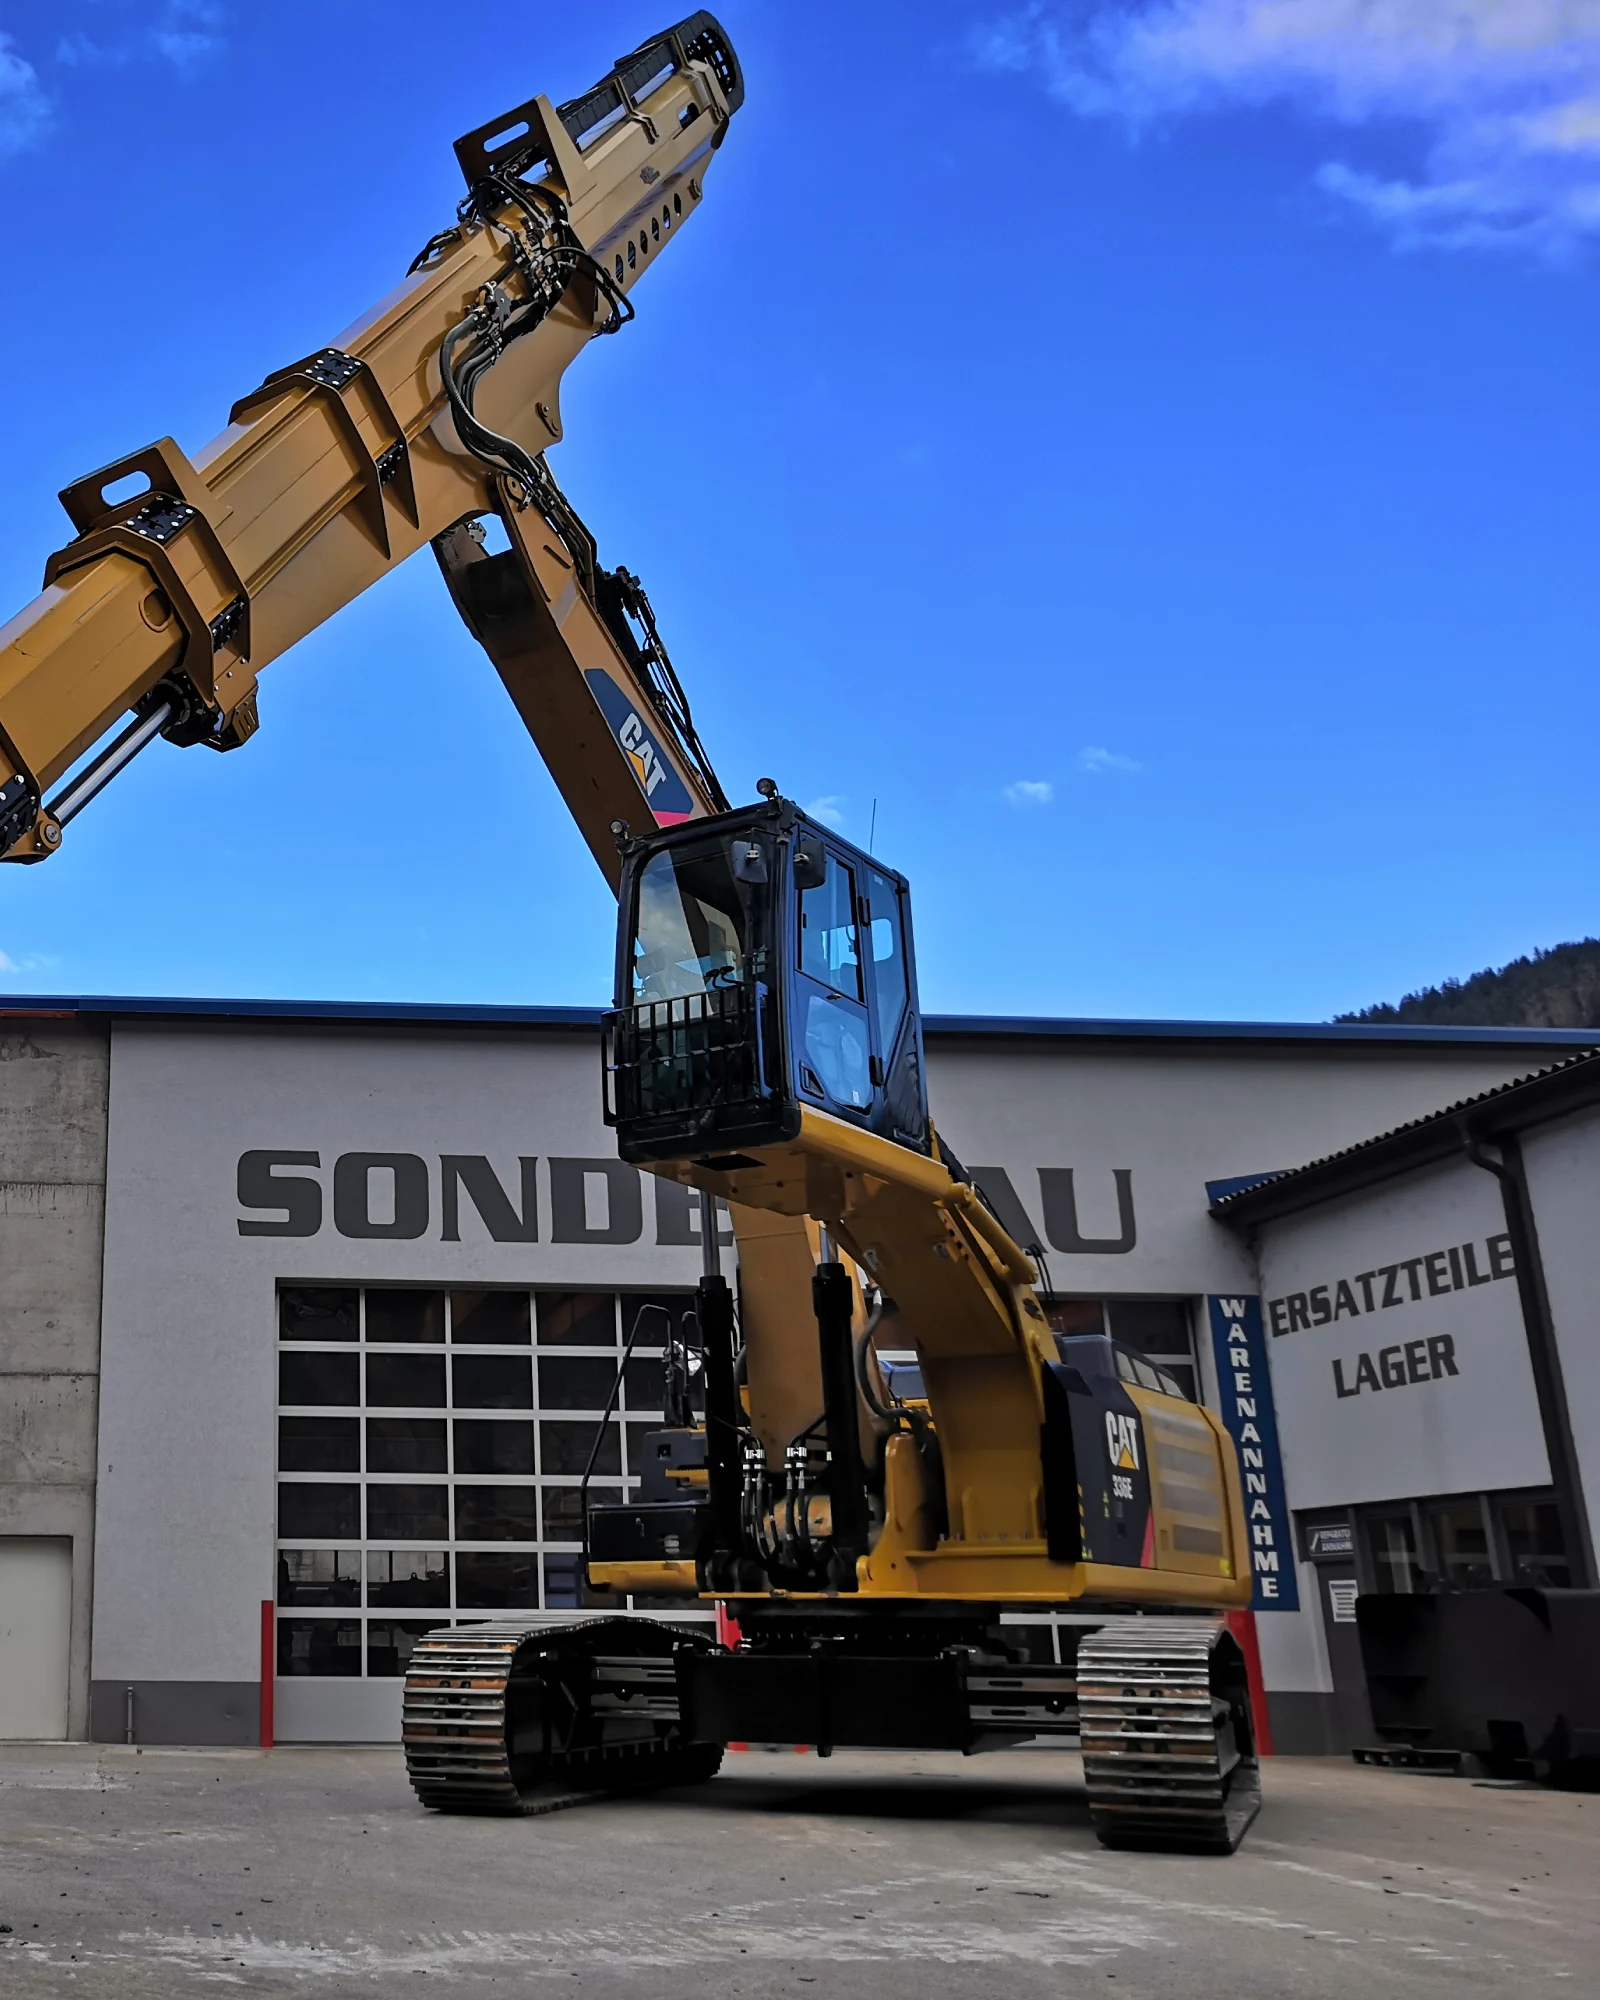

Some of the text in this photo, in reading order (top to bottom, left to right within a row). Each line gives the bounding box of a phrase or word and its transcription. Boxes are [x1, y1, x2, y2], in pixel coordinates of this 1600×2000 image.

[620, 713, 667, 796] CAT
[1268, 1233, 1516, 1338] ERSATZTEILE
[1332, 1334, 1459, 1398] LAGER
[1105, 1411, 1139, 1470] CAT
[1218, 1299, 1279, 1598] WARENANNAHME
